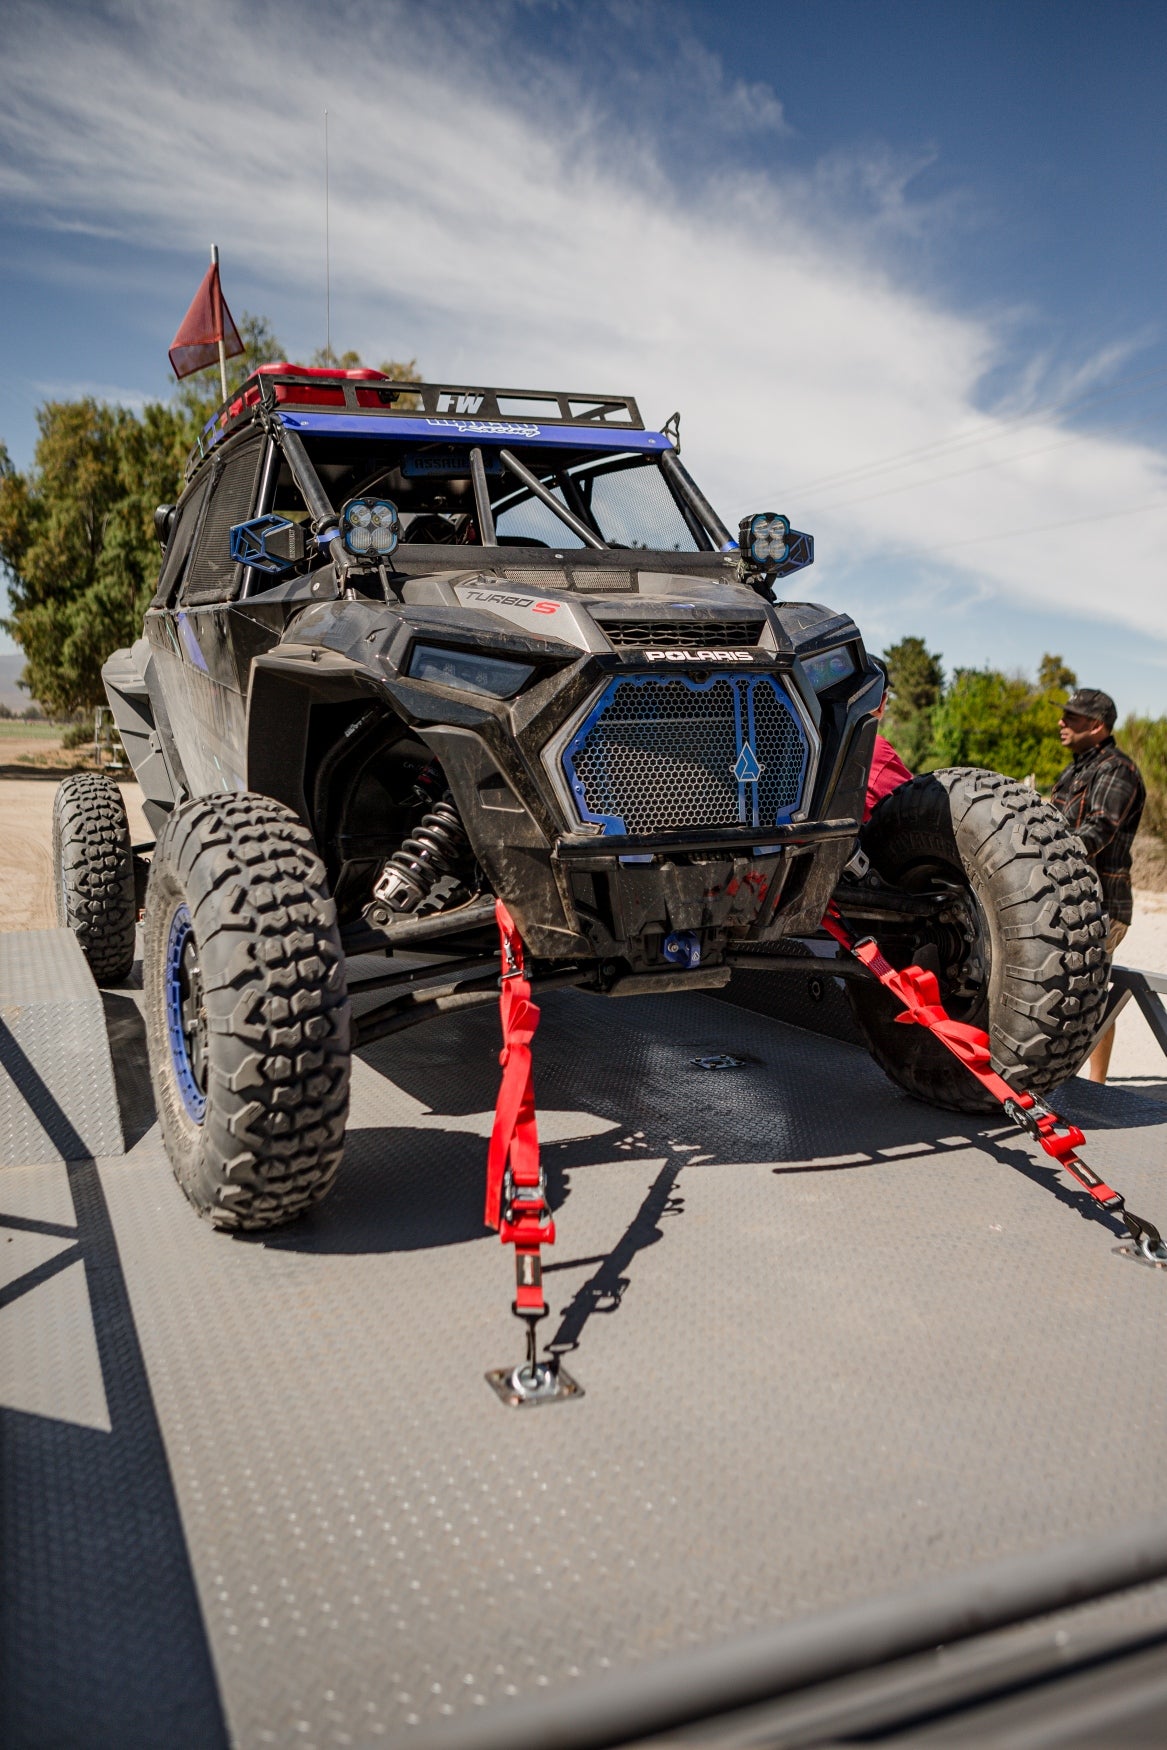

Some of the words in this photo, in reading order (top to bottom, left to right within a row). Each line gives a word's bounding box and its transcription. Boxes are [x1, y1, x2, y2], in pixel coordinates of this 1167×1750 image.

[436, 391, 484, 414] FW
[466, 591, 534, 608] TURBO
[532, 602, 560, 614] S
[645, 651, 754, 661] POLARIS
